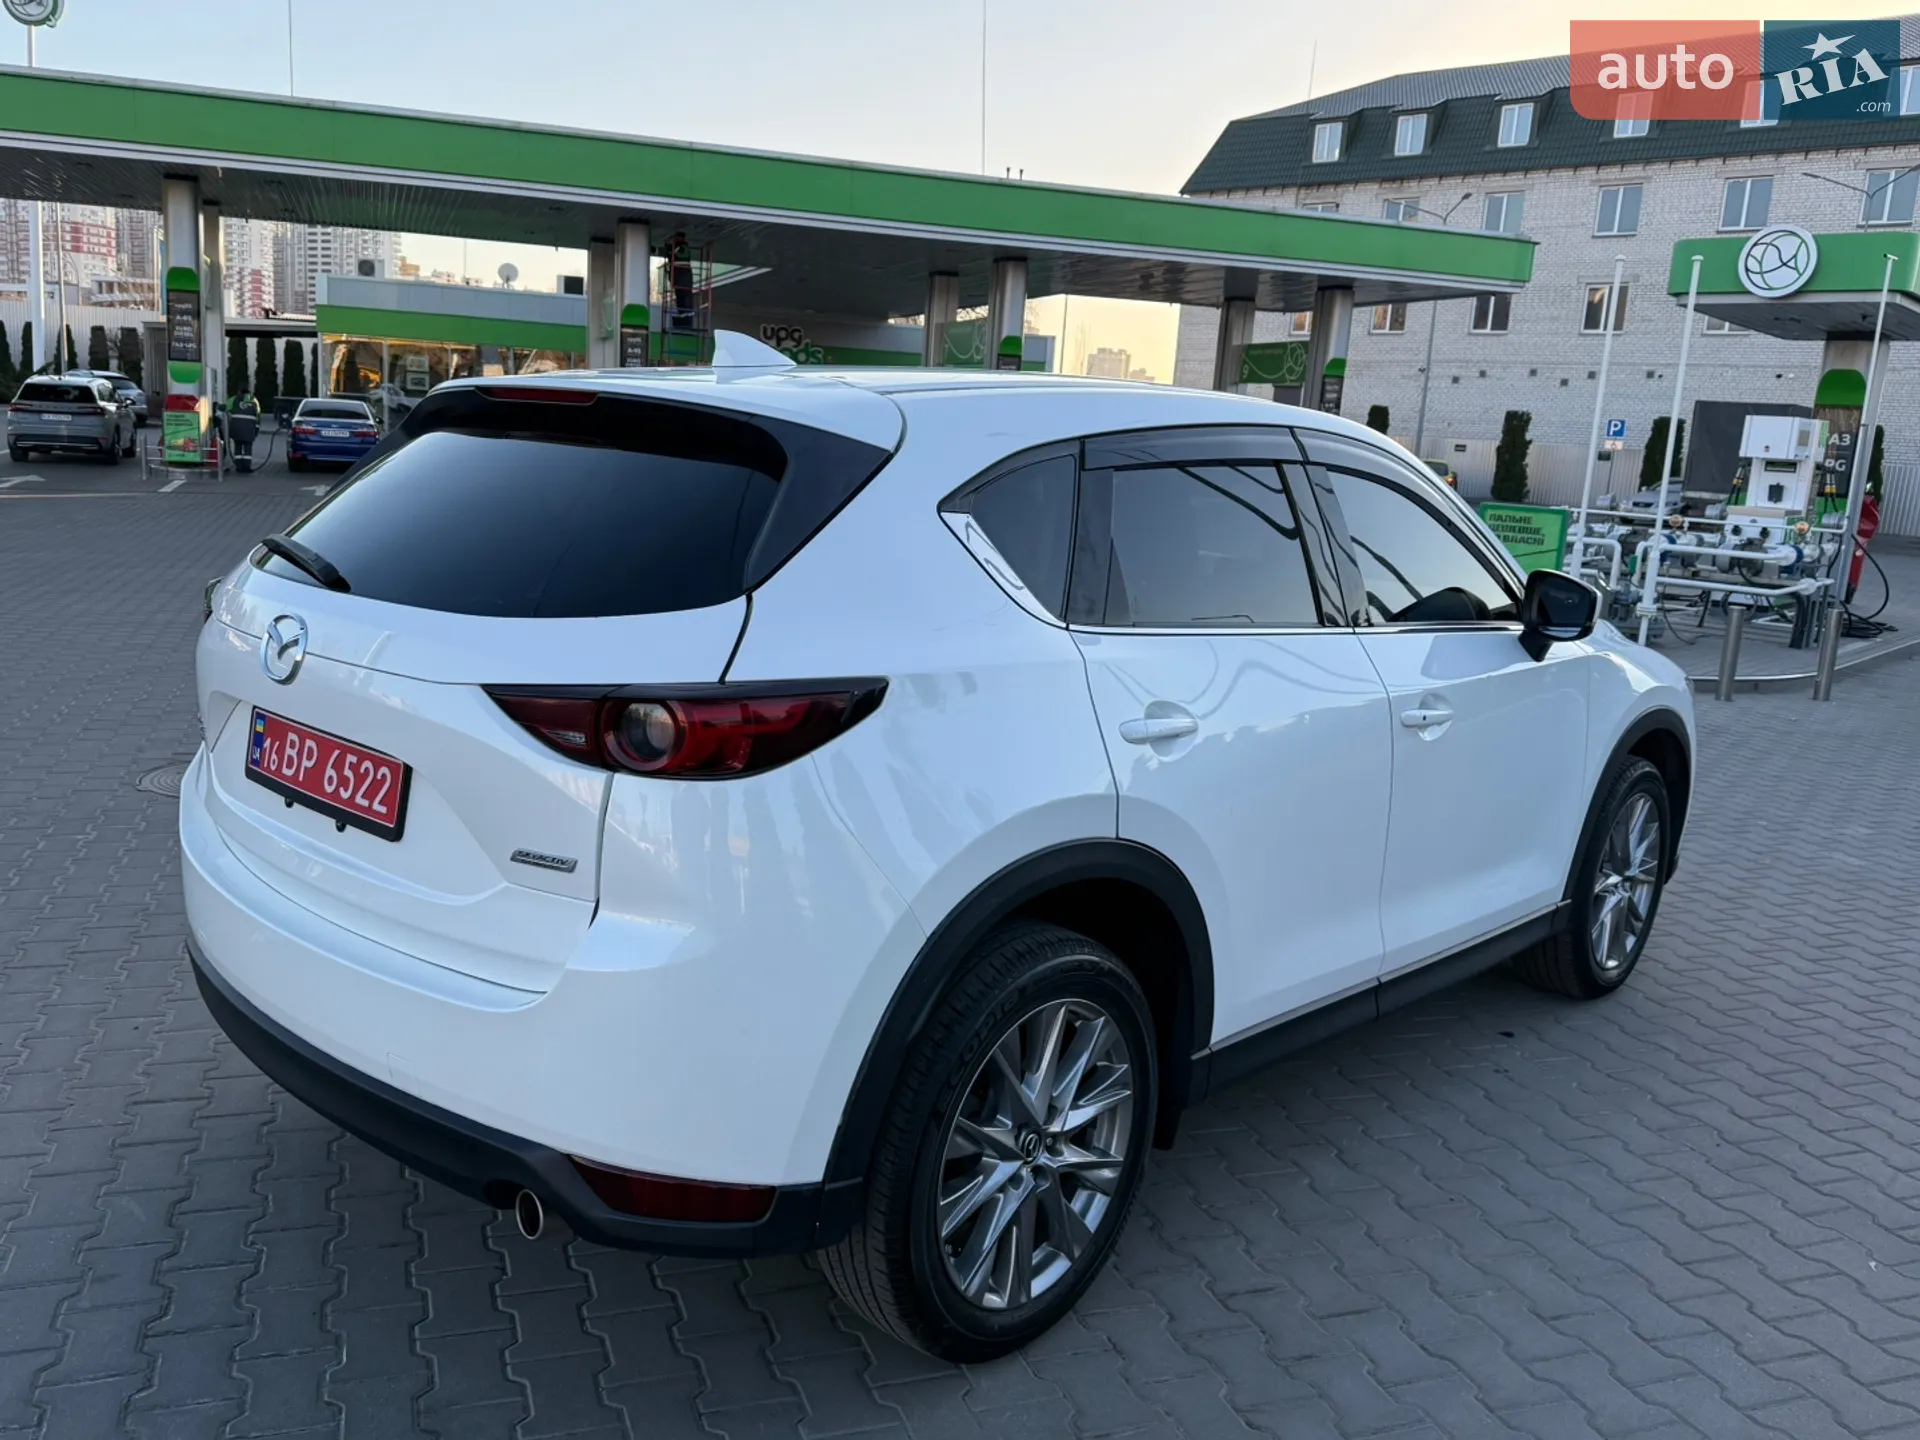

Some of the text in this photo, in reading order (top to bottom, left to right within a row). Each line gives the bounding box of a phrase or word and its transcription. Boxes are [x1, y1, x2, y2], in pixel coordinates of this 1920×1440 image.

[761, 325, 803, 348] upg
[1609, 420, 1622, 436] P
[1828, 432, 1851, 446] АЗ
[1824, 458, 1847, 471] PG
[1489, 513, 1533, 525] ПАЛЬНЕ
[323, 749, 393, 815] 6522
